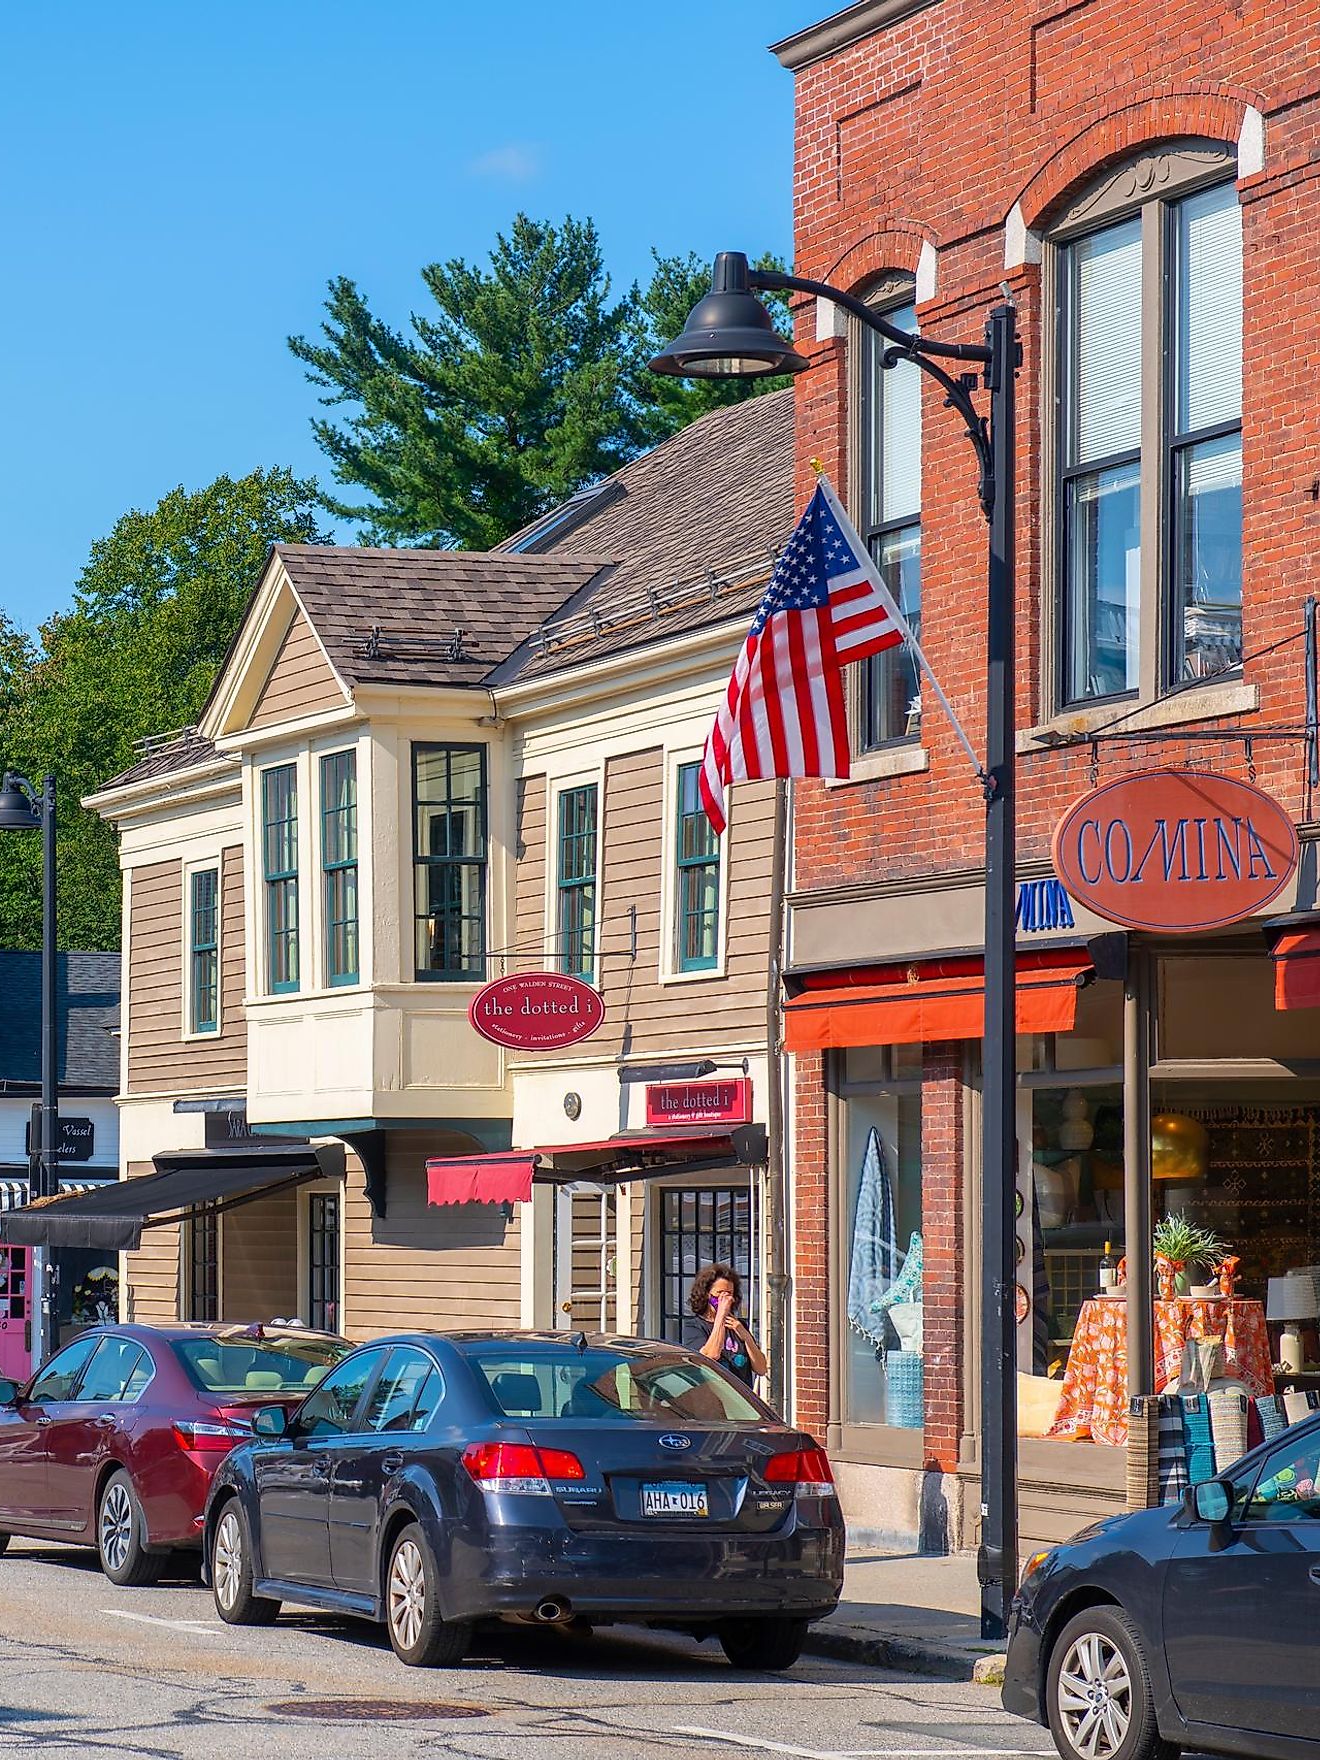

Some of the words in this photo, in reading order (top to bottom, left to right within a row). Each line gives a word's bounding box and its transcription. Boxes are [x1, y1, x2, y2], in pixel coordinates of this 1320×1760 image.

[1077, 815, 1278, 886] COMINA
[1015, 879, 1075, 933] MINA
[502, 984, 518, 993] ONE
[519, 981, 547, 989] WALDEN
[547, 981, 575, 992] STREET
[483, 996, 513, 1016] the
[520, 995, 579, 1015] dotted
[586, 998, 593, 1013] i
[491, 1023, 522, 1041] stationery
[530, 1031, 566, 1041] invitations
[661, 1088, 679, 1110] the
[683, 1085, 720, 1109] dotted
[723, 1089, 729, 1106] i
[555, 1486, 602, 1494] SUBARU
[646, 1491, 671, 1510] AHA
[680, 1491, 705, 1510] 016
